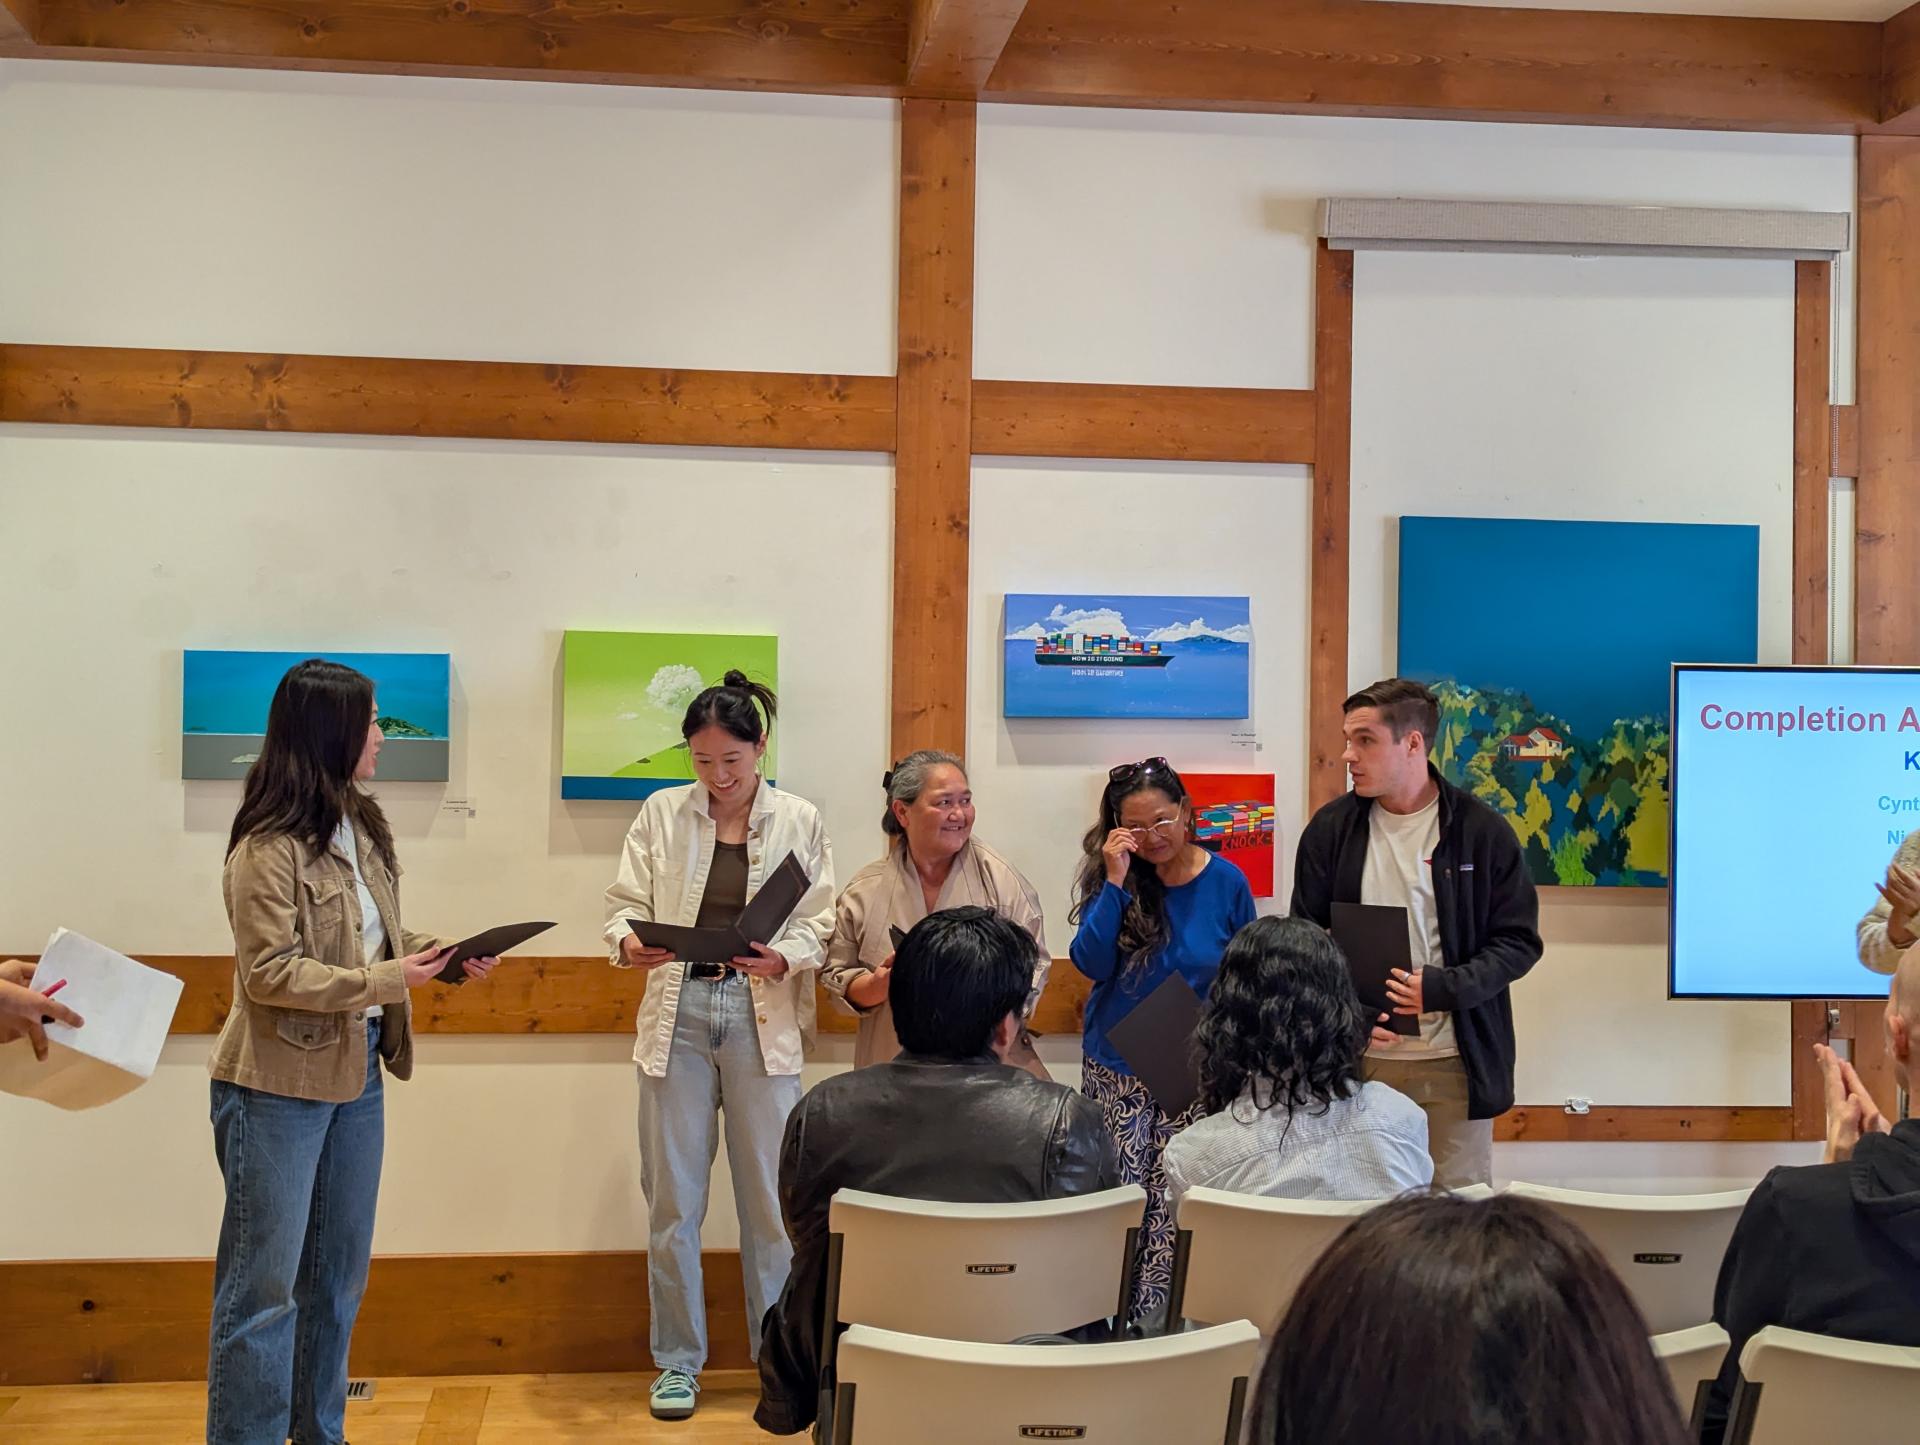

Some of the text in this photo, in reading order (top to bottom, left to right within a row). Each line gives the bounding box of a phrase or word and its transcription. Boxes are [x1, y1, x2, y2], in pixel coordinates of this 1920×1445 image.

[1700, 704, 1886, 737] Completion
[1878, 795, 1920, 815] Cynt
[1221, 832, 1274, 851] KNOCK-
[1027, 1428, 1078, 1436] LIFETIME
